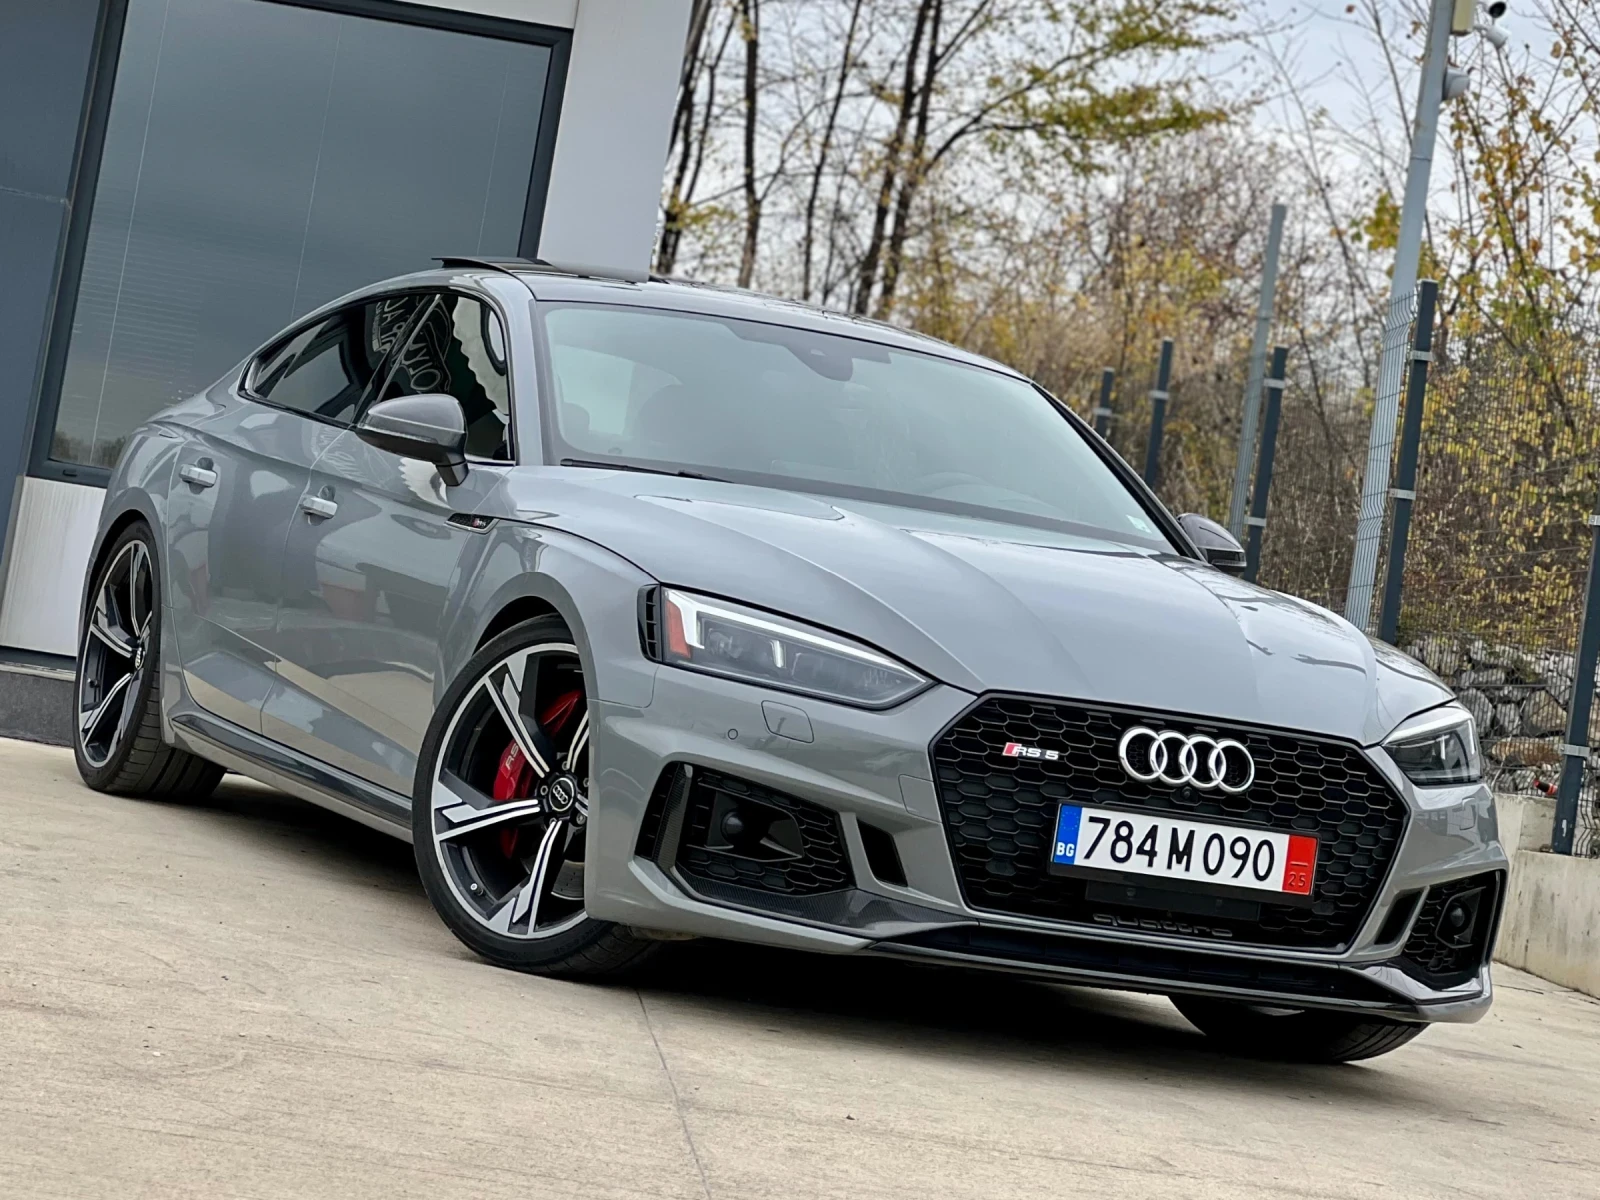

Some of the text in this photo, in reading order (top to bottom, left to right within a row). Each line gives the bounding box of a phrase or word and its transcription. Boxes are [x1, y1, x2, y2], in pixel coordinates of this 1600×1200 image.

[1056, 842, 1075, 857] BG
[1288, 871, 1306, 888] 25
[1093, 913, 1233, 937] quattro
